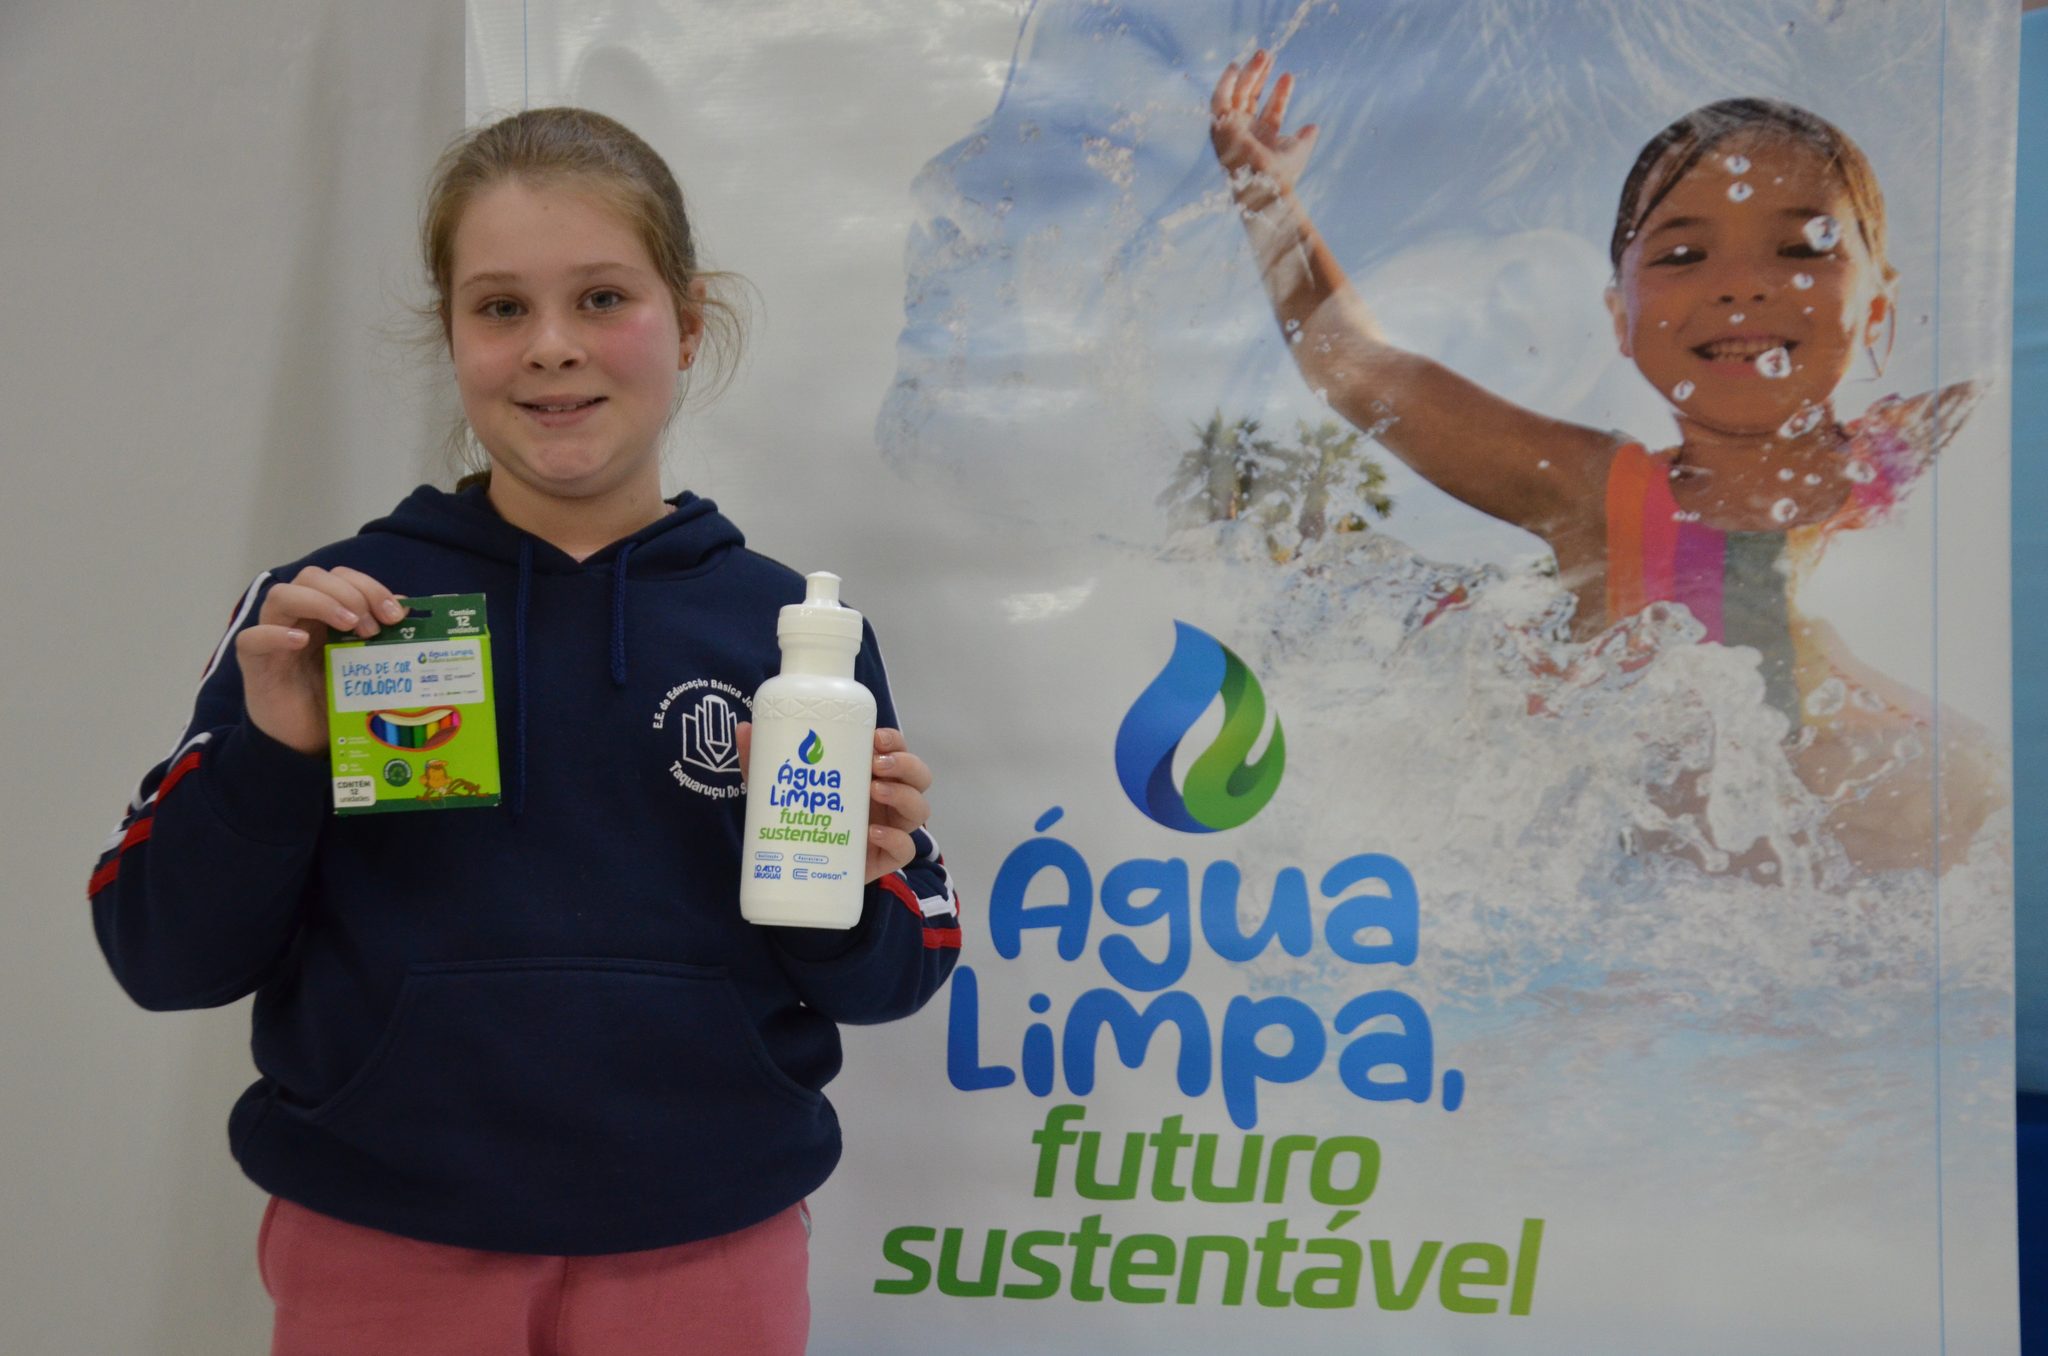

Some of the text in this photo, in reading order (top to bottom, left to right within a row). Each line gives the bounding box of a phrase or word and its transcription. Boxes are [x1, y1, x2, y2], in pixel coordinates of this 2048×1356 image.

[456, 616, 470, 626] 12
[375, 662, 389, 674] DE
[394, 661, 411, 673] COR
[344, 676, 412, 696] ECOLÓGICO
[659, 698, 671, 711] de
[666, 678, 709, 701] Educação
[710, 679, 742, 699] Básica
[336, 780, 371, 789] CONTÉM
[669, 760, 726, 800] Taquaruçu
[727, 785, 739, 798] Do
[778, 758, 841, 790] Água
[339, 795, 370, 803] unidades
[770, 784, 844, 814] Limpa,
[779, 807, 832, 827] futuro
[758, 826, 850, 846] sustentável
[989, 807, 1420, 992] Água
[947, 966, 1465, 1131] Limpa,
[1032, 1104, 1381, 1206] futuro
[872, 1210, 1546, 1316] sustentável
